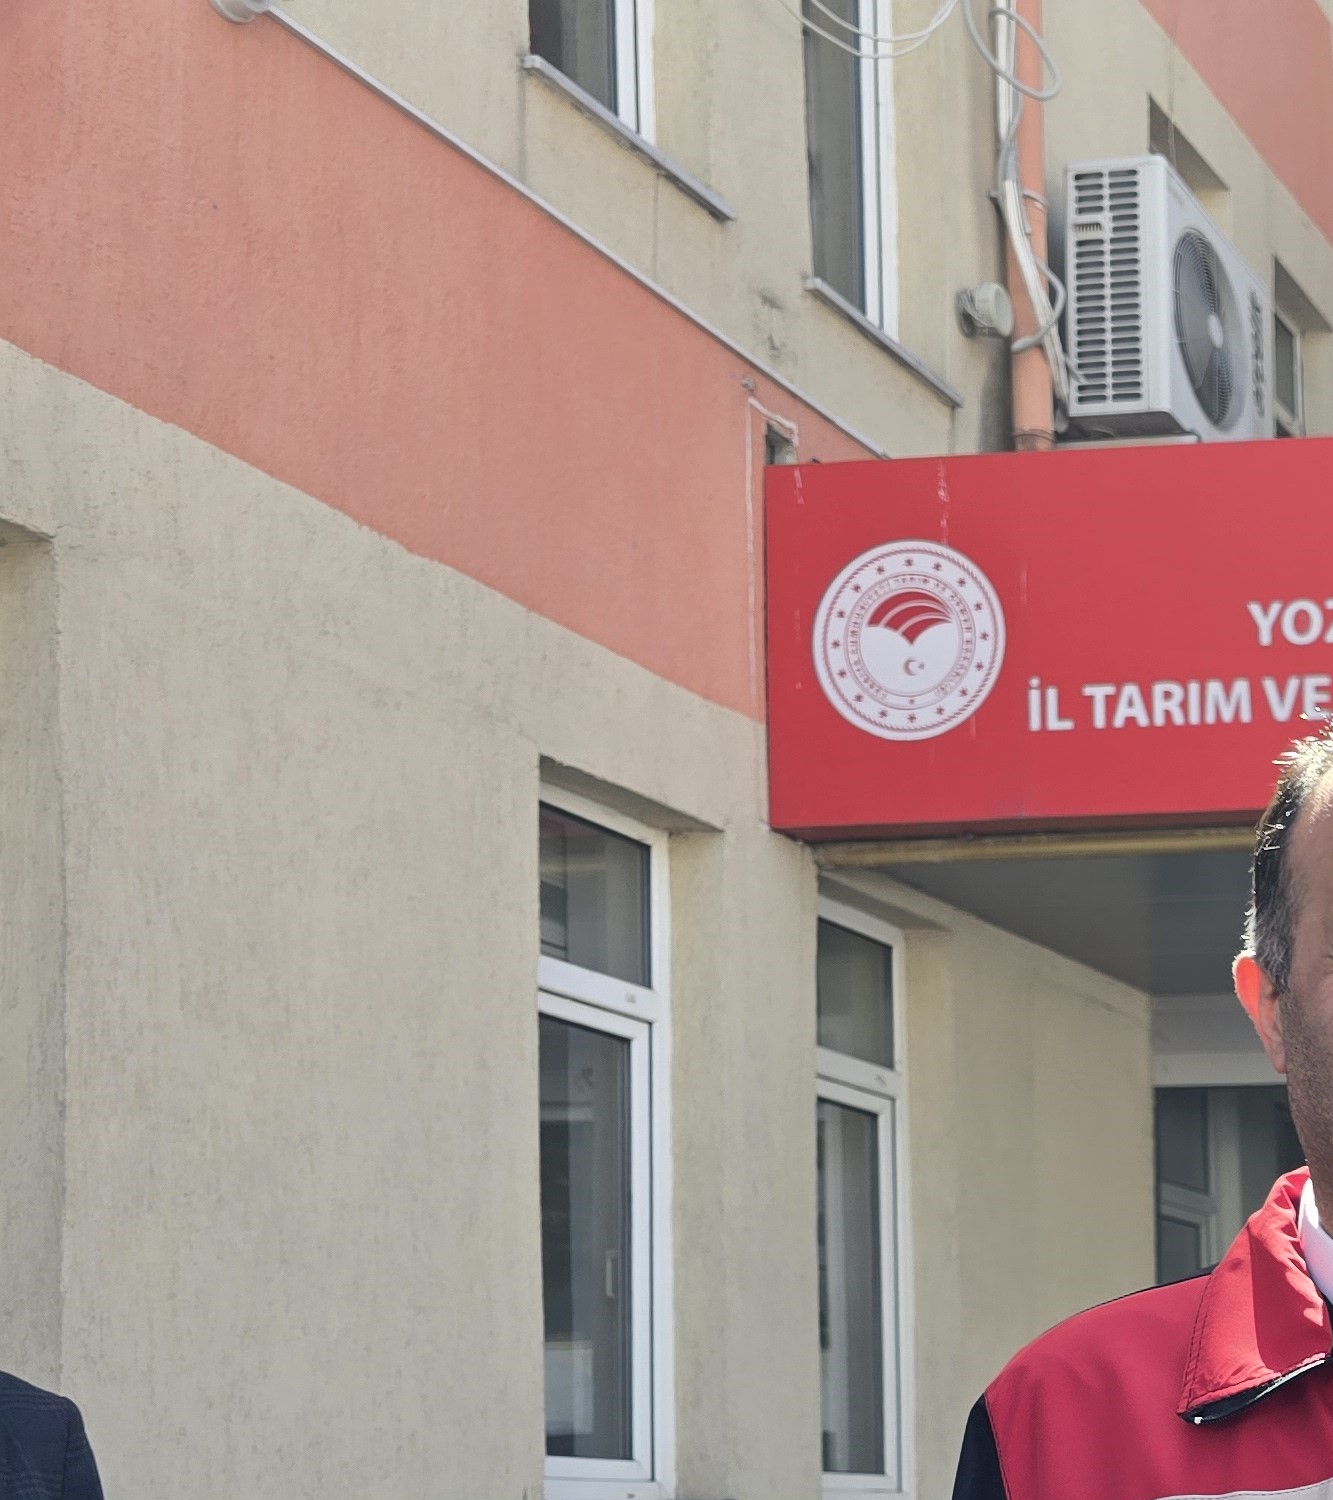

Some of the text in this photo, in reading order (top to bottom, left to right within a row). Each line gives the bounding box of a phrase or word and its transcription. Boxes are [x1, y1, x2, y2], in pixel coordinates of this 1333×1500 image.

[1028, 676, 1075, 732] İL
[1082, 677, 1253, 729] TARIM
[1261, 673, 1333, 722] VE
